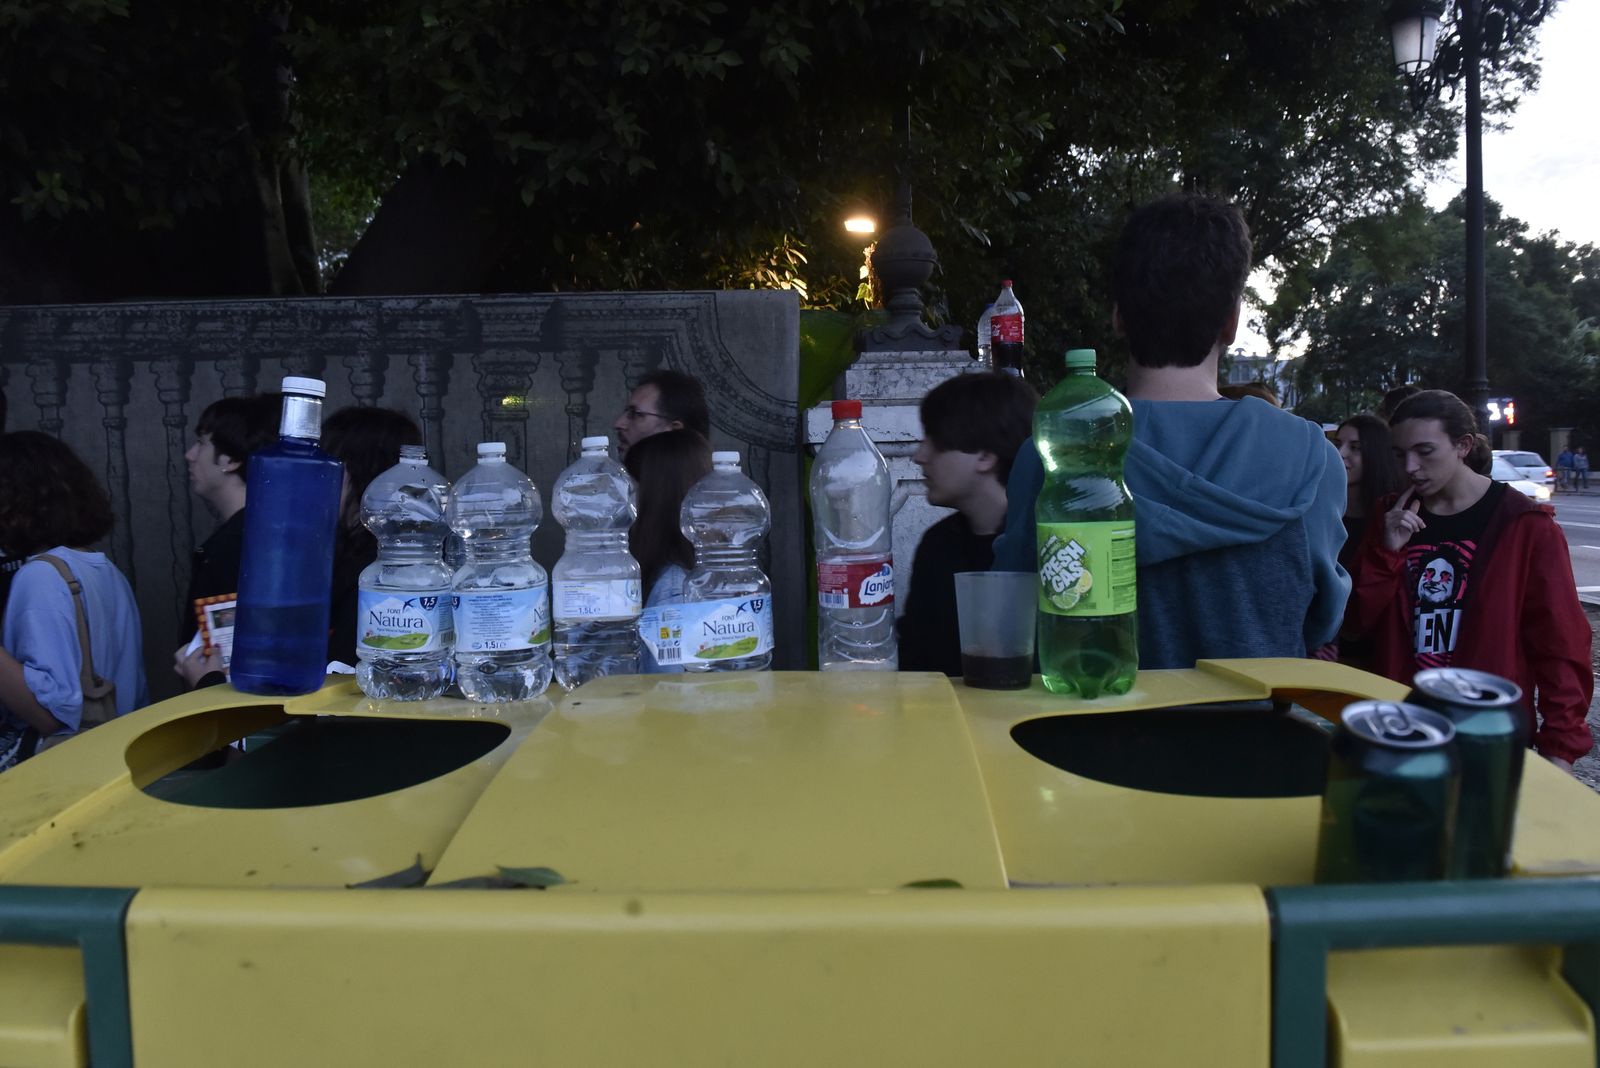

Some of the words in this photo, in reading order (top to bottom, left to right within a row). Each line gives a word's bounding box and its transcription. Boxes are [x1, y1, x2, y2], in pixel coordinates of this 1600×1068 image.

[1039, 538, 1086, 586] FRESH
[1051, 560, 1085, 593] GAS
[369, 610, 424, 628] Natura
[721, 614, 735, 622] FONT
[703, 620, 755, 636] Natura
